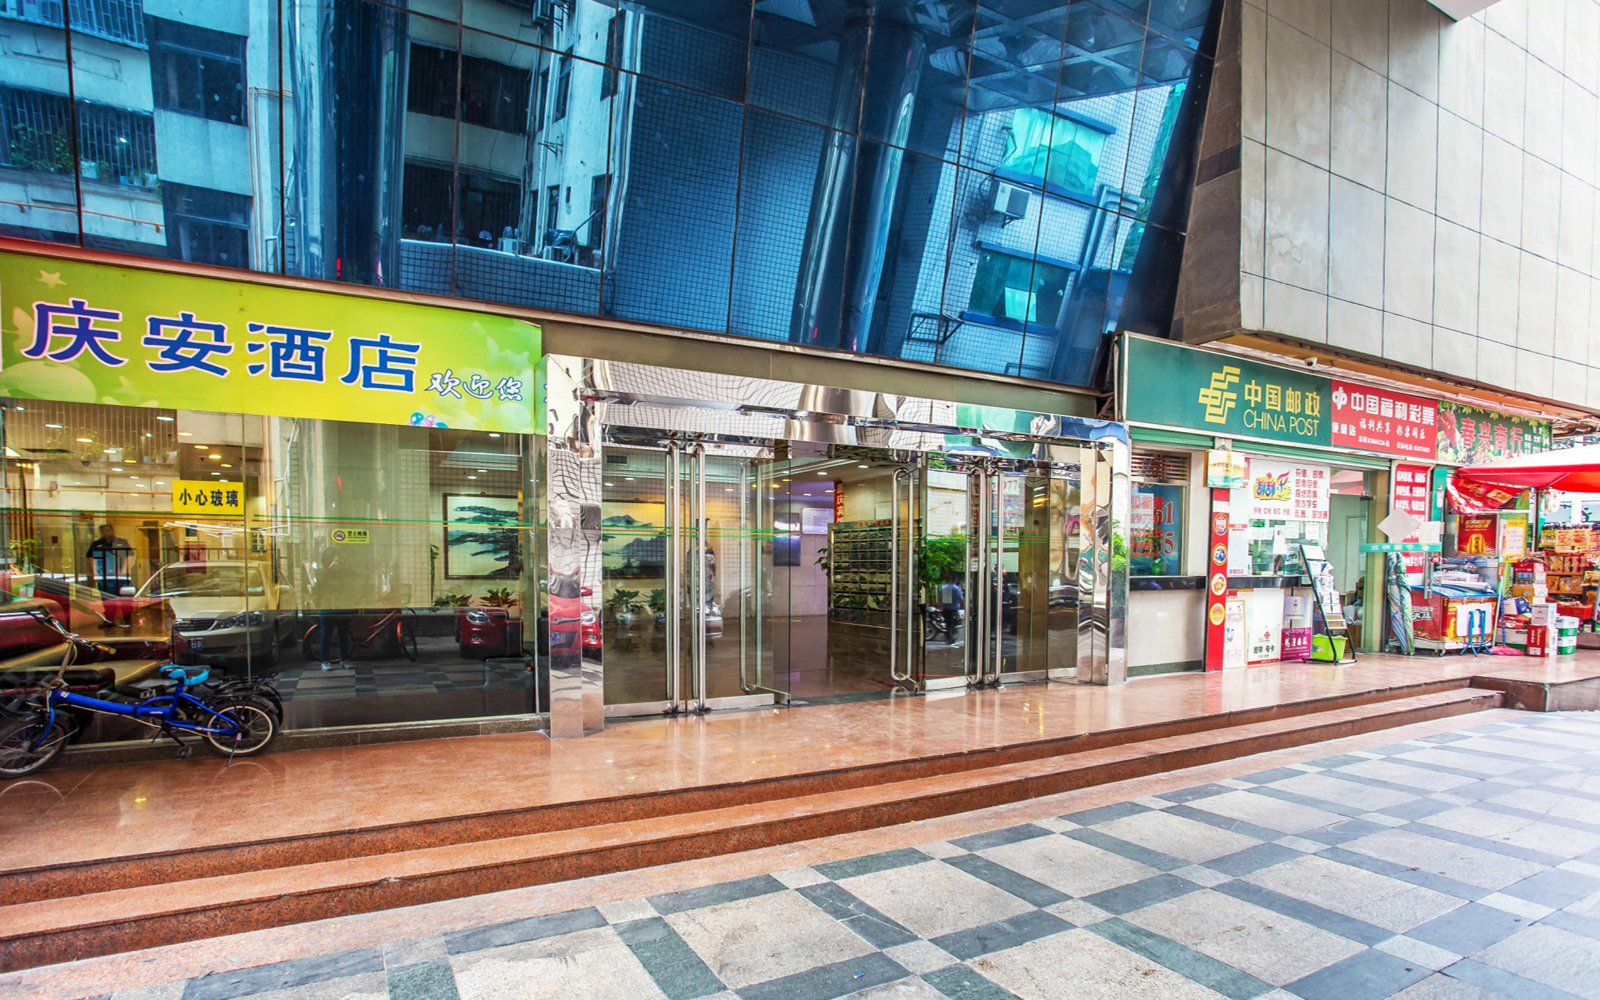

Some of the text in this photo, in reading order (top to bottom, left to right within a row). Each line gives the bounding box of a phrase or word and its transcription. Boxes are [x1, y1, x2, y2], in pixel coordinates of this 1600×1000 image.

[20, 297, 421, 393] 庆安酒店
[424, 368, 523, 401] 欢迎您
[1244, 379, 1320, 417] 中国邮政
[1243, 409, 1319, 437] CHINA POST
[1351, 392, 1434, 426] 中国福利彩票
[1461, 418, 1523, 457] 春兴商行
[179, 488, 239, 508] 小心玻璃
